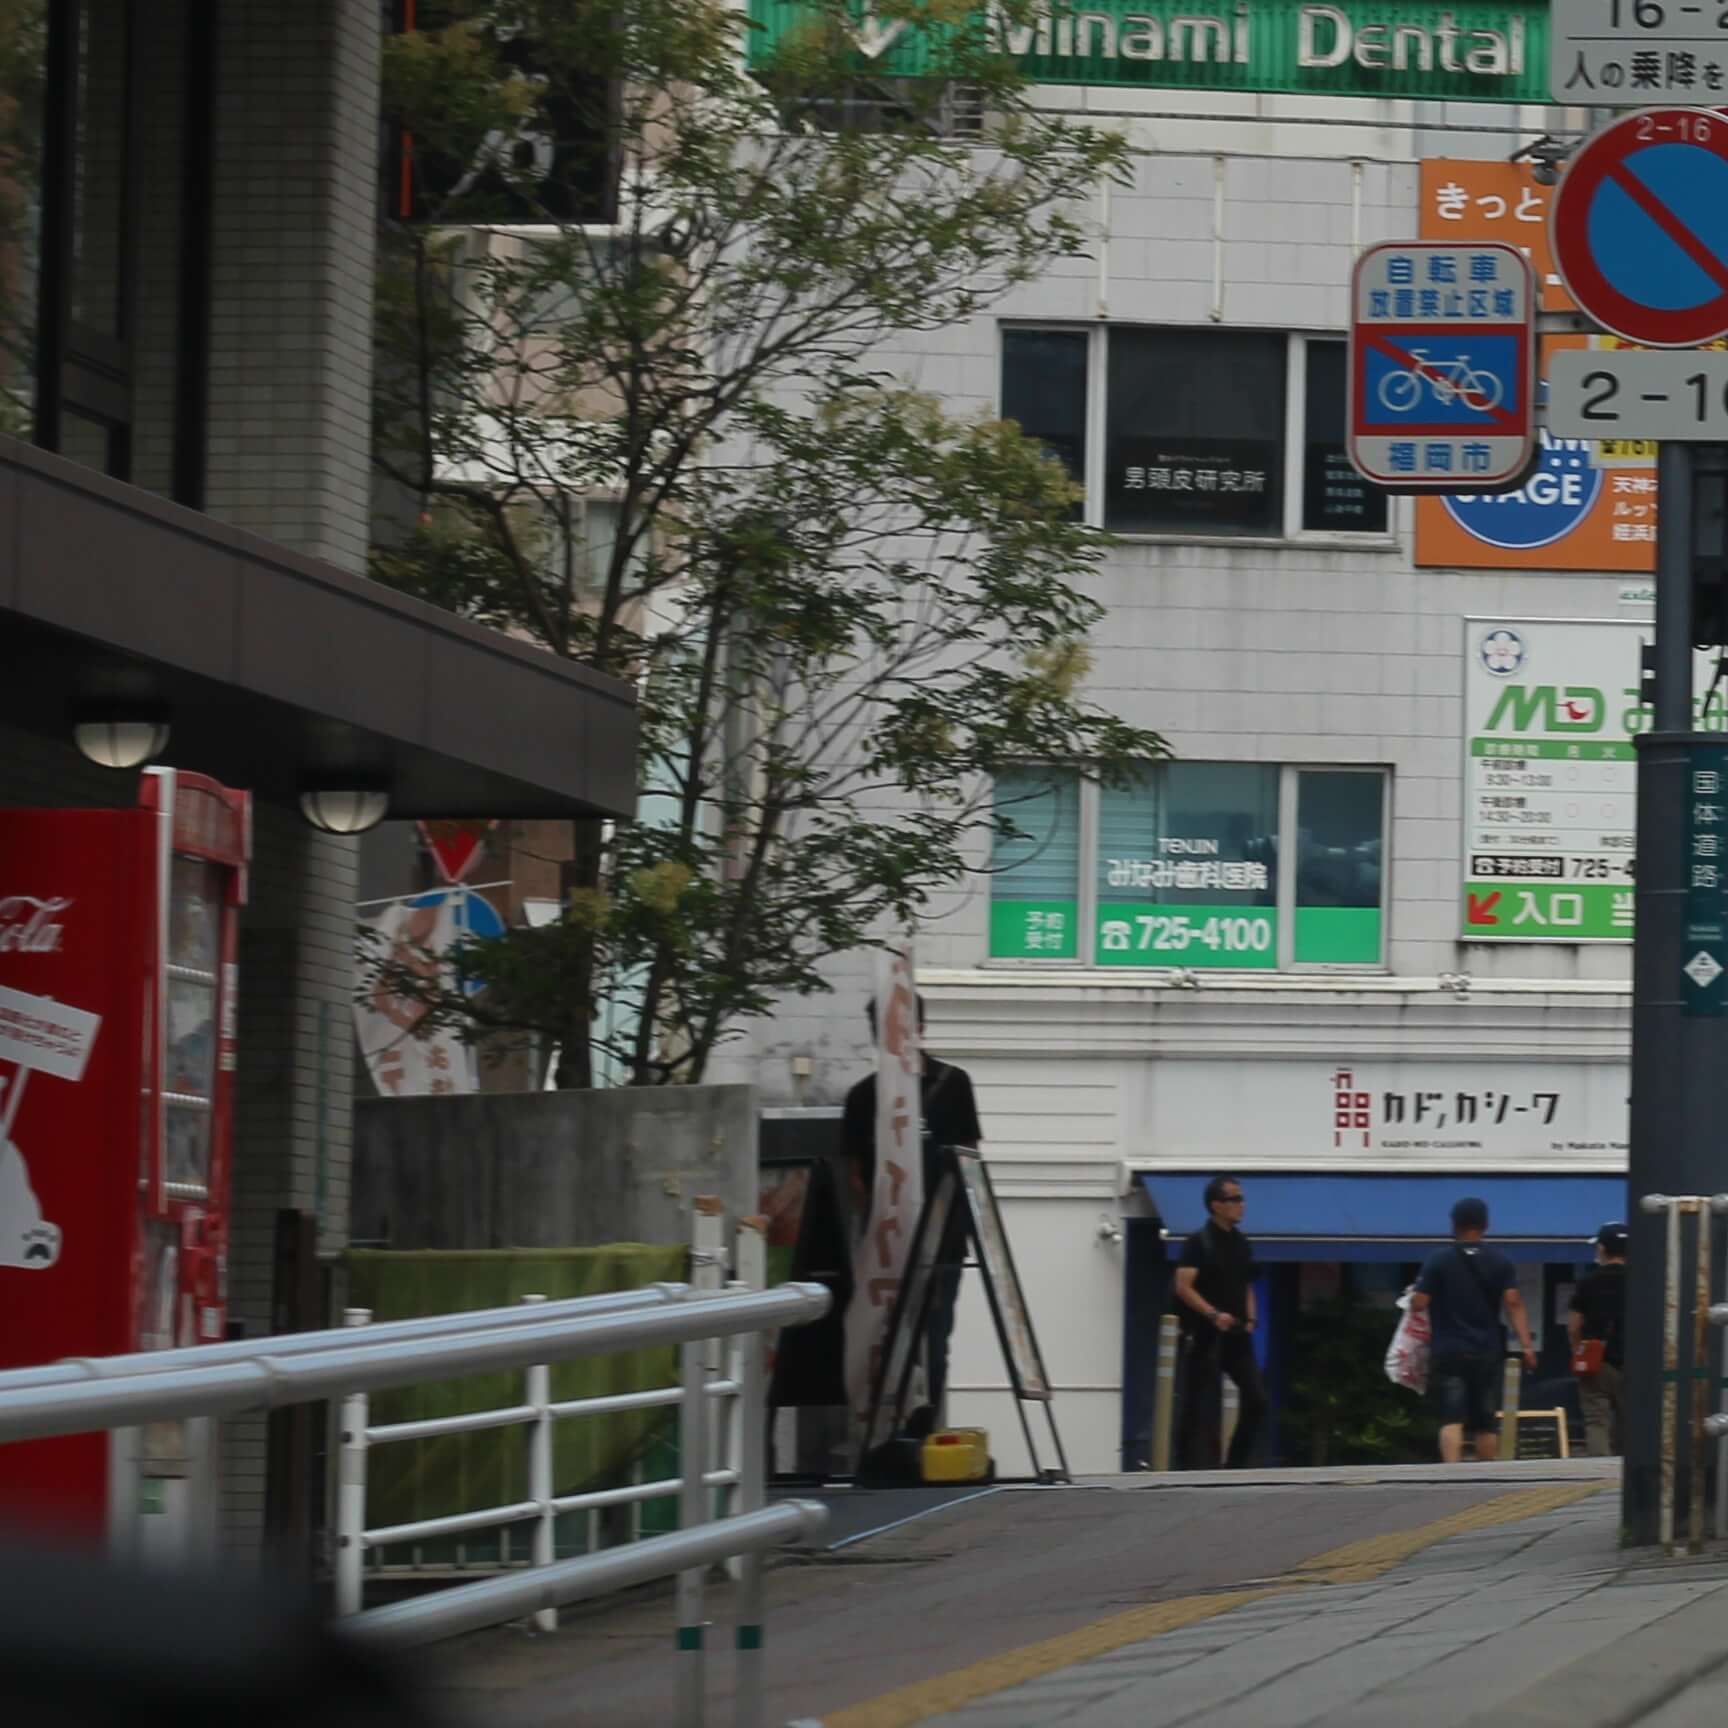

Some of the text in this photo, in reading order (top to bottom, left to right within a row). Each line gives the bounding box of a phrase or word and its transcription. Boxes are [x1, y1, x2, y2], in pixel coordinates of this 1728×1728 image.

[1299, 3, 1527, 76] Dental
[1635, 116, 1712, 143] 2-16
[1436, 181, 1544, 223] きっと
[1387, 255, 1498, 285] 自転車
[1369, 288, 1515, 318] 放置禁止区域
[1389, 442, 1491, 472] 福岡市
[1455, 473, 1583, 505] AGE
[1691, 770, 1721, 888] 国体道路
[1159, 837, 1219, 854] TENJIN
[1106, 859, 1268, 891] みなみ歯科医院
[1511, 891, 1583, 927] 入口
[1136, 915, 1271, 952] 725-4100
